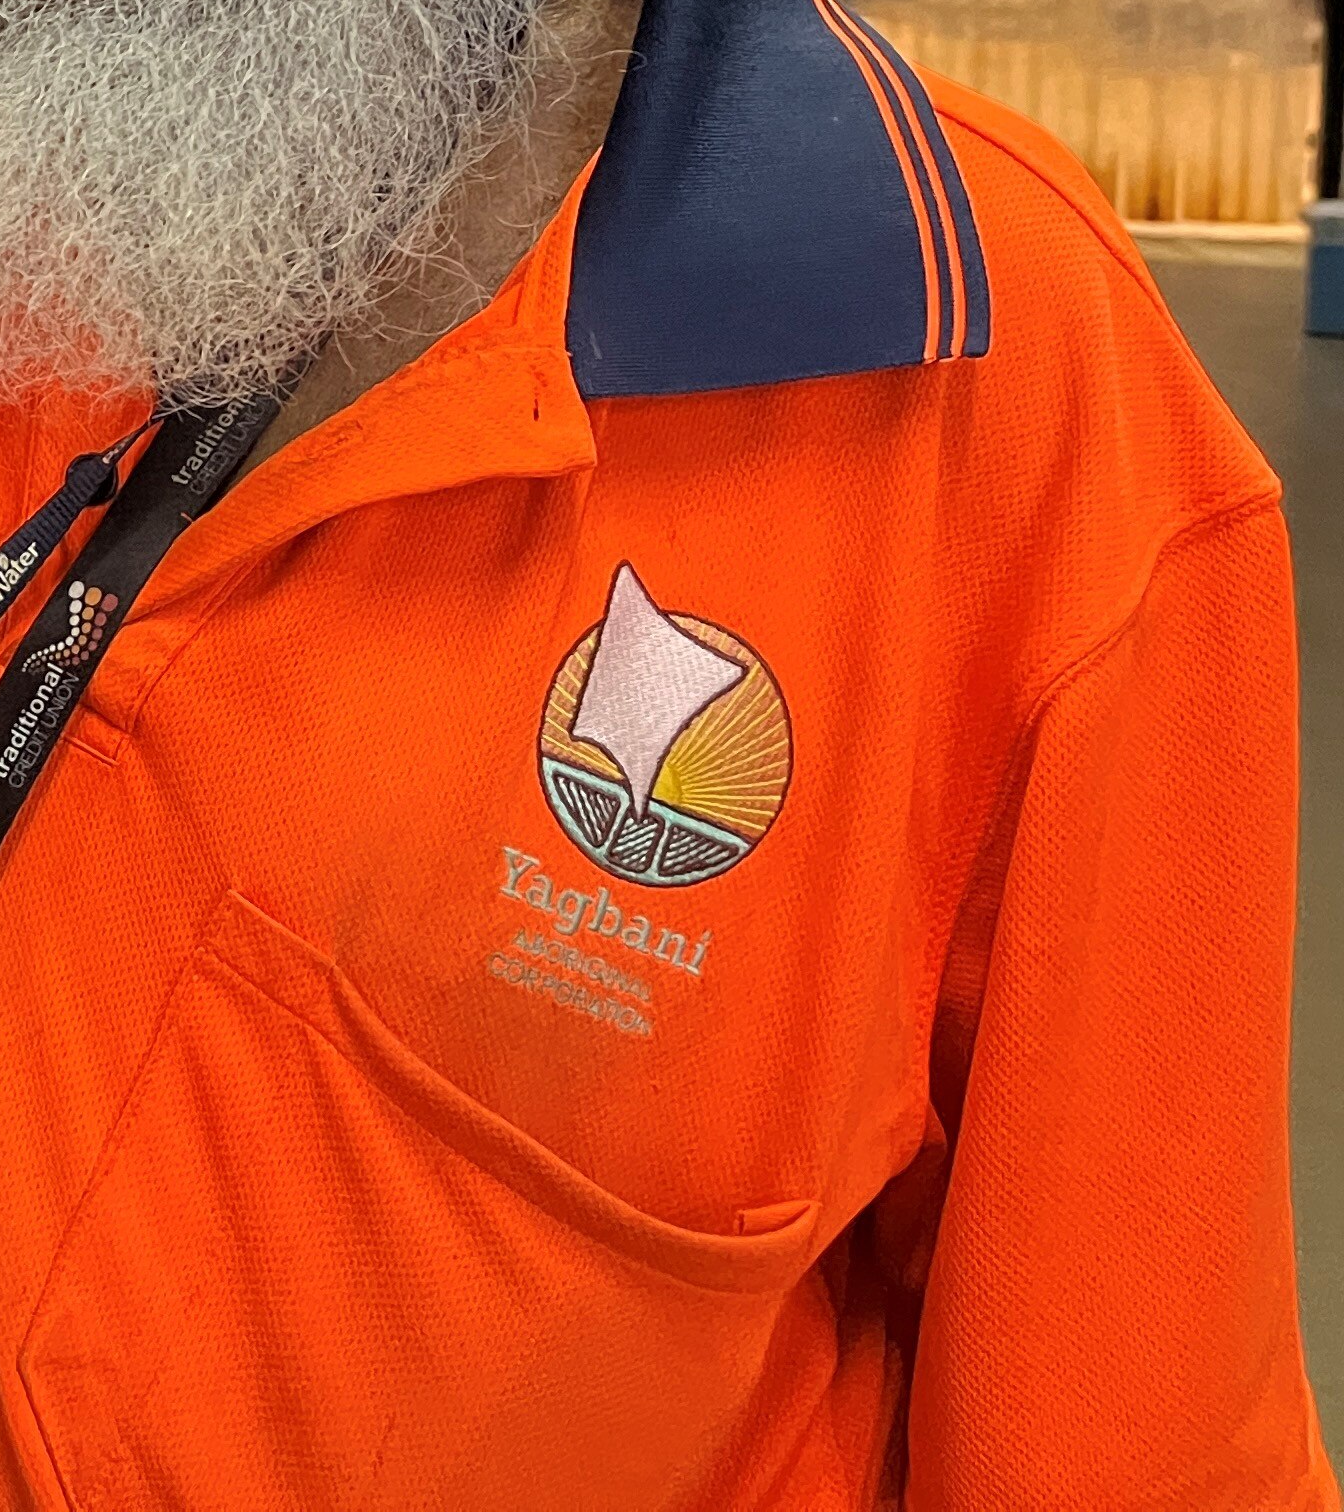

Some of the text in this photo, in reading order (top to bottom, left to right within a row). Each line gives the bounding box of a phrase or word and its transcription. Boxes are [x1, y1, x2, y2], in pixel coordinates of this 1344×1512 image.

[8, 671, 80, 788] CREDIT UNION
[499, 844, 710, 978] Yagbani
[486, 951, 655, 1038] CORPORATION
